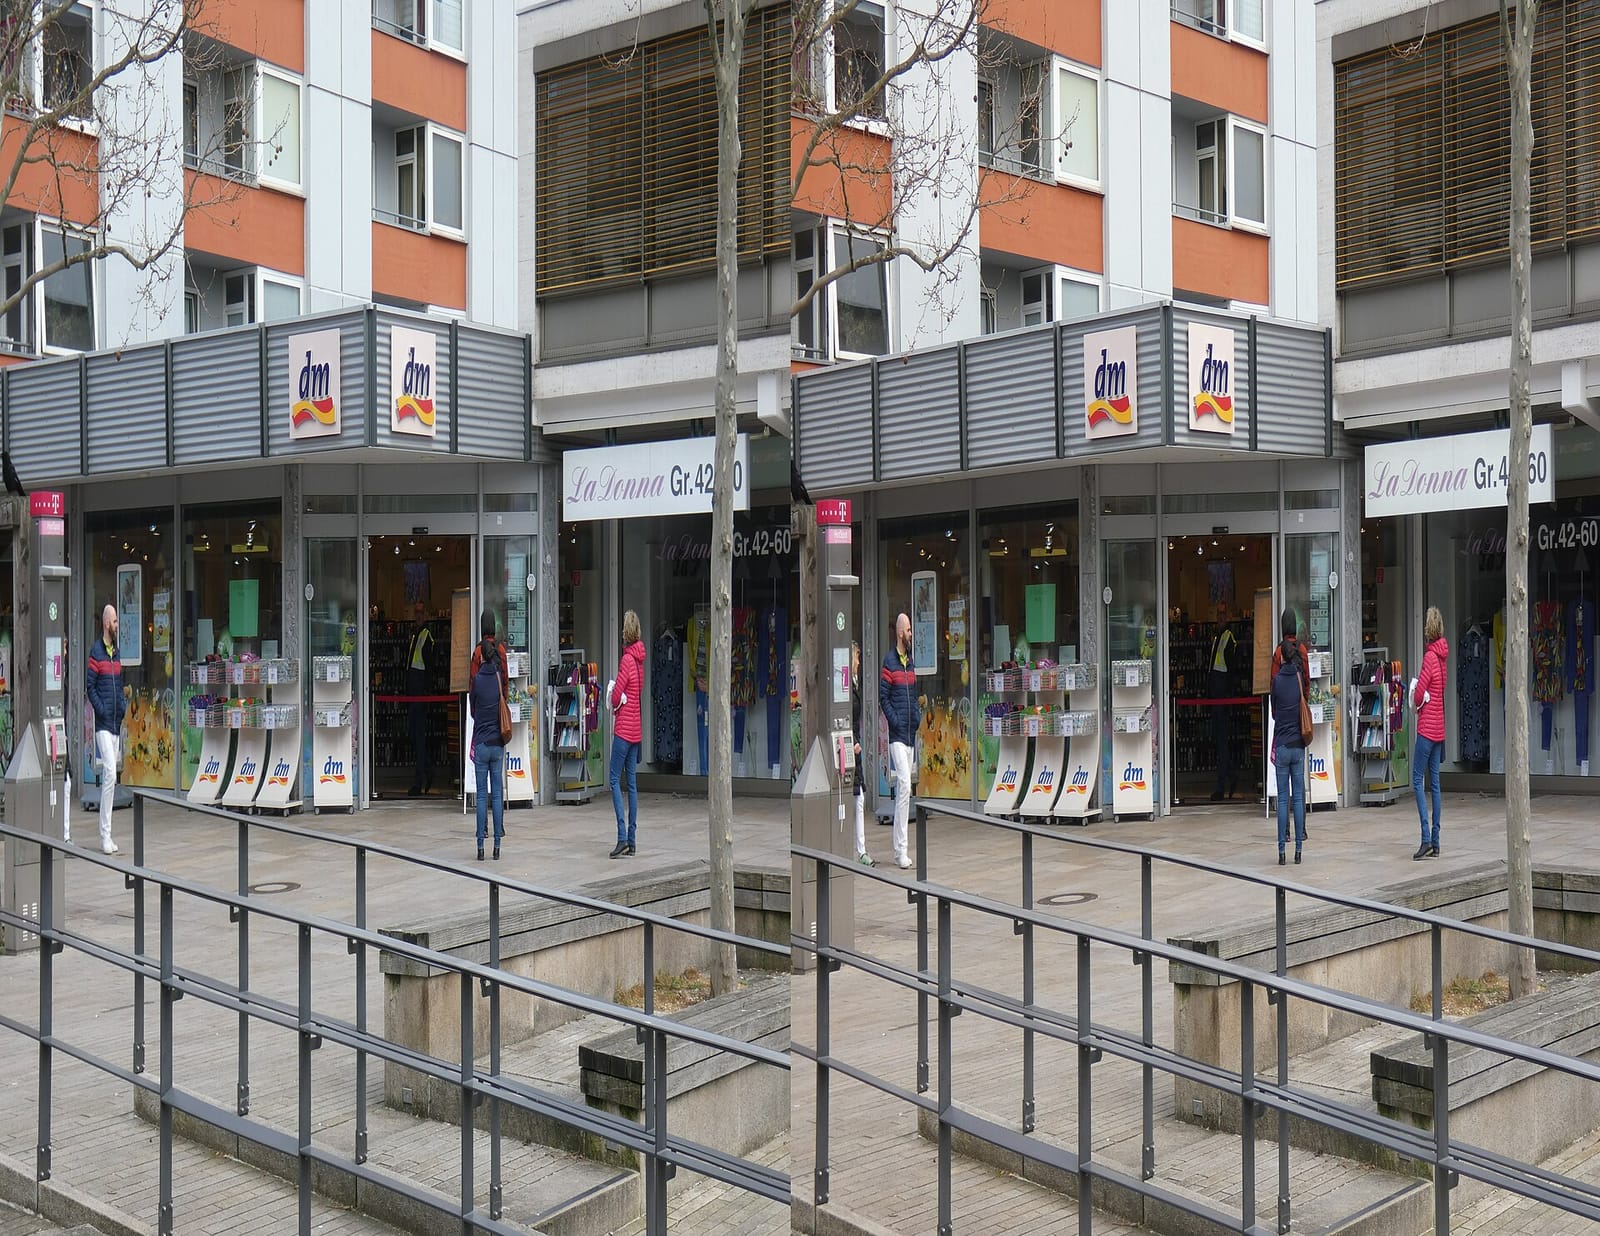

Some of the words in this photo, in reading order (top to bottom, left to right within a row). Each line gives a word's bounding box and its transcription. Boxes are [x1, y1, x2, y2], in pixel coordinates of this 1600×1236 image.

[299, 350, 330, 399] dm
[403, 347, 430, 396] dm
[1094, 349, 1126, 398] dm
[1201, 344, 1229, 393] dm
[204, 755, 220, 774] dm
[240, 756, 256, 775] dm
[274, 757, 290, 776] dm
[324, 755, 343, 775] dm
[1001, 764, 1017, 784] dm
[1123, 762, 1143, 781] dm
[1038, 765, 1054, 785] dm
[1072, 765, 1089, 785] dm
